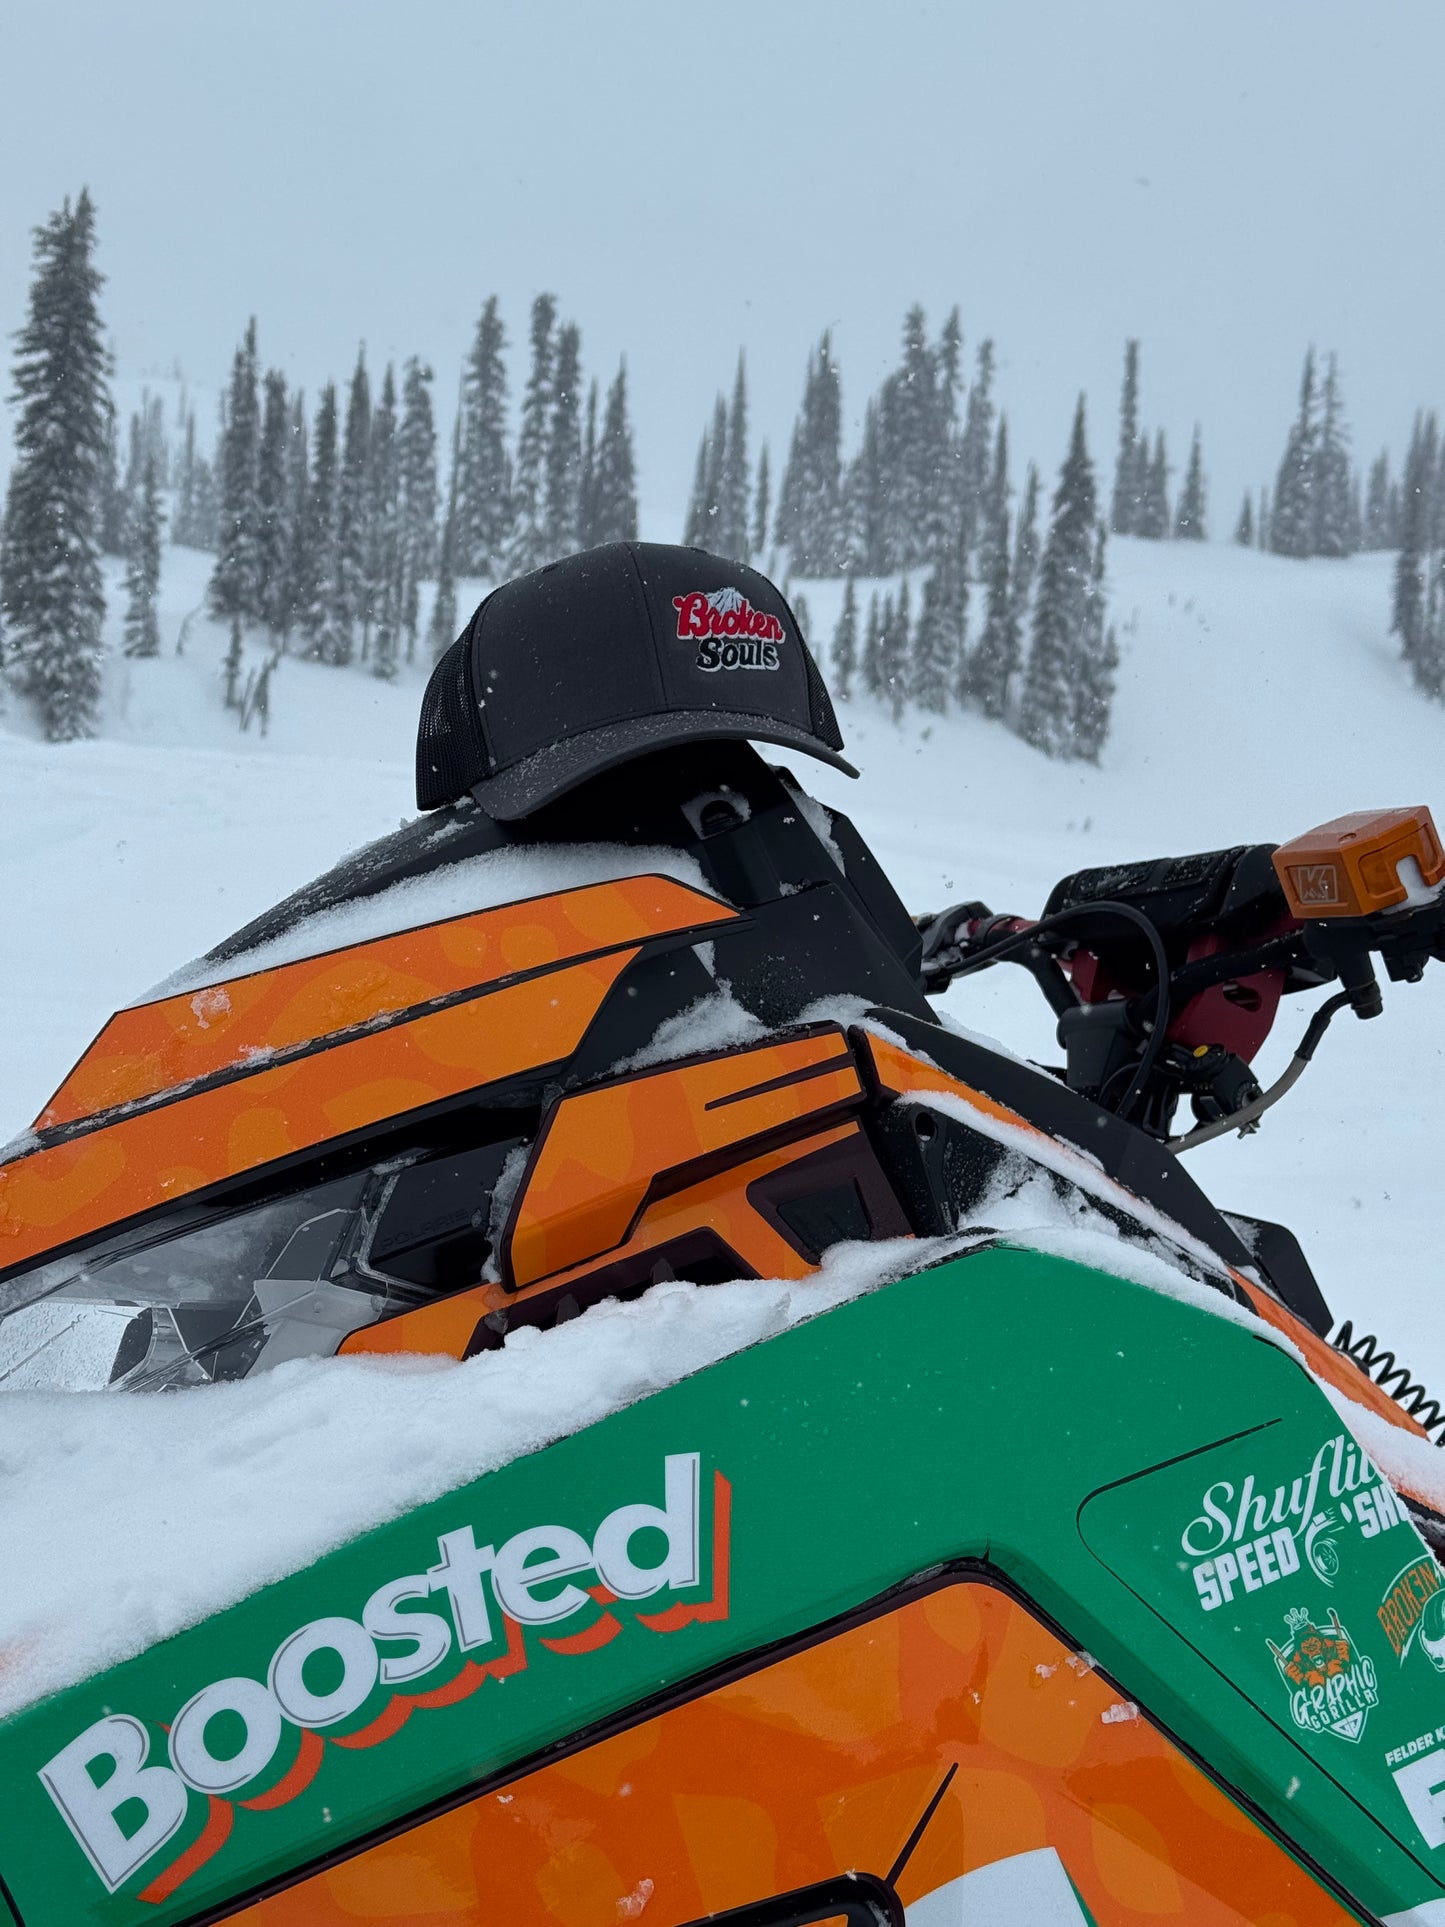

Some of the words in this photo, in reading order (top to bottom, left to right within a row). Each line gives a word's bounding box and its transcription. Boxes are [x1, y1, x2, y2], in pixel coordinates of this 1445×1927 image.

[672, 592, 785, 643] Broken
[697, 638, 779, 671] Souls
[1192, 1526, 1301, 1612] SPEED
[37, 1451, 701, 1893] Boosted
[1293, 1659, 1375, 1727] GRAPHIC
[1310, 1688, 1376, 1730] GORILLA
[1384, 1731, 1435, 1767] FELDER
